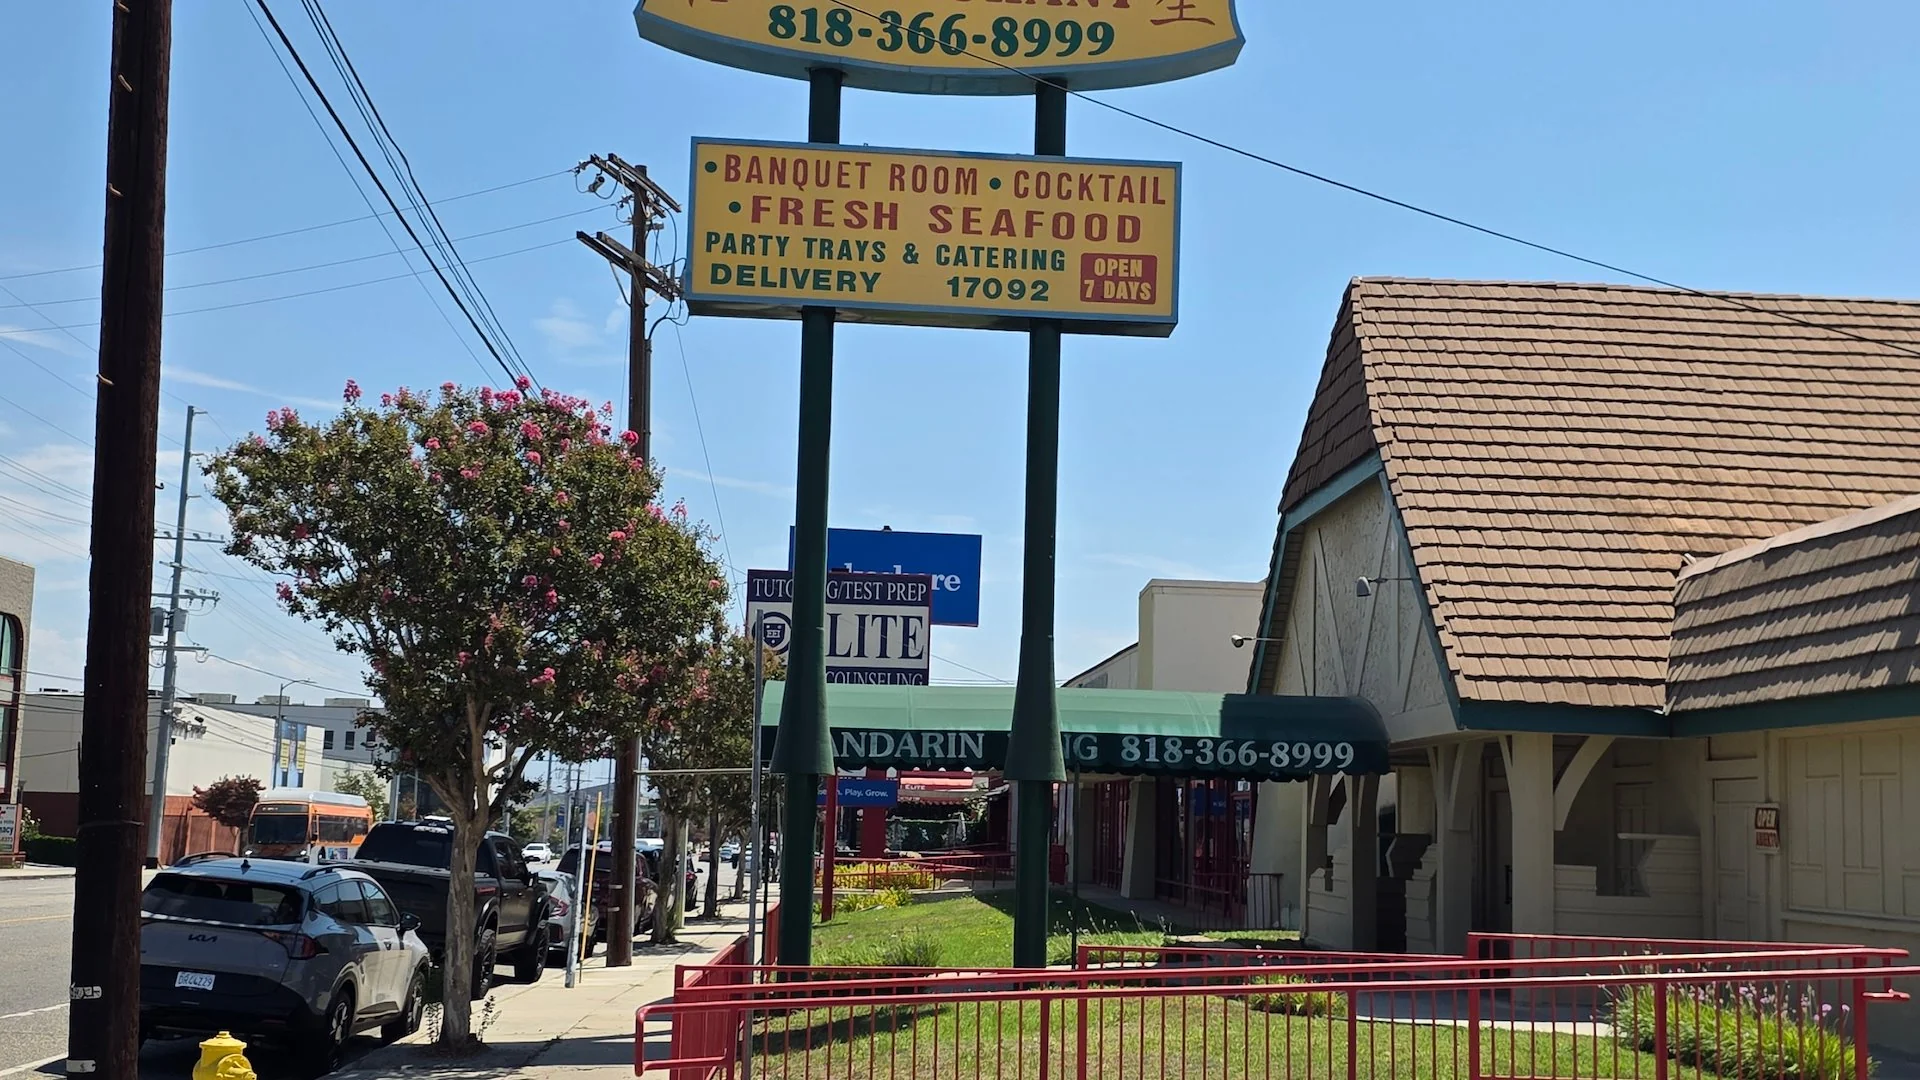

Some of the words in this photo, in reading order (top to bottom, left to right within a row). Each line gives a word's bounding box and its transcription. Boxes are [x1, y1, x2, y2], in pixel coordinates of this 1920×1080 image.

[767, 4, 1115, 58] 818-366-8999
[724, 154, 872, 192] BANQUET
[889, 162, 978, 196] ROOM
[1013, 169, 1166, 206] COCKTAIL
[750, 195, 899, 231] FRESH
[927, 204, 1142, 244] SEAFOOD
[705, 231, 790, 257] PARTY
[802, 236, 886, 263] TRAYS
[902, 242, 919, 265] &
[935, 243, 1066, 272] CATERING
[1093, 257, 1143, 278] OPEN
[710, 263, 882, 293] DELIVERY
[946, 275, 1049, 302] 17092
[1083, 278, 1095, 299] 7
[1102, 279, 1152, 301] DAYS
[887, 582, 927, 602] PREP
[825, 612, 924, 660] LITE
[832, 731, 985, 760] NDARIN
[1120, 735, 1355, 769] 818-366-8999
[845, 788, 864, 798] Play.
[865, 789, 889, 798] Grow.
[1758, 809, 1776, 827] OPEN
